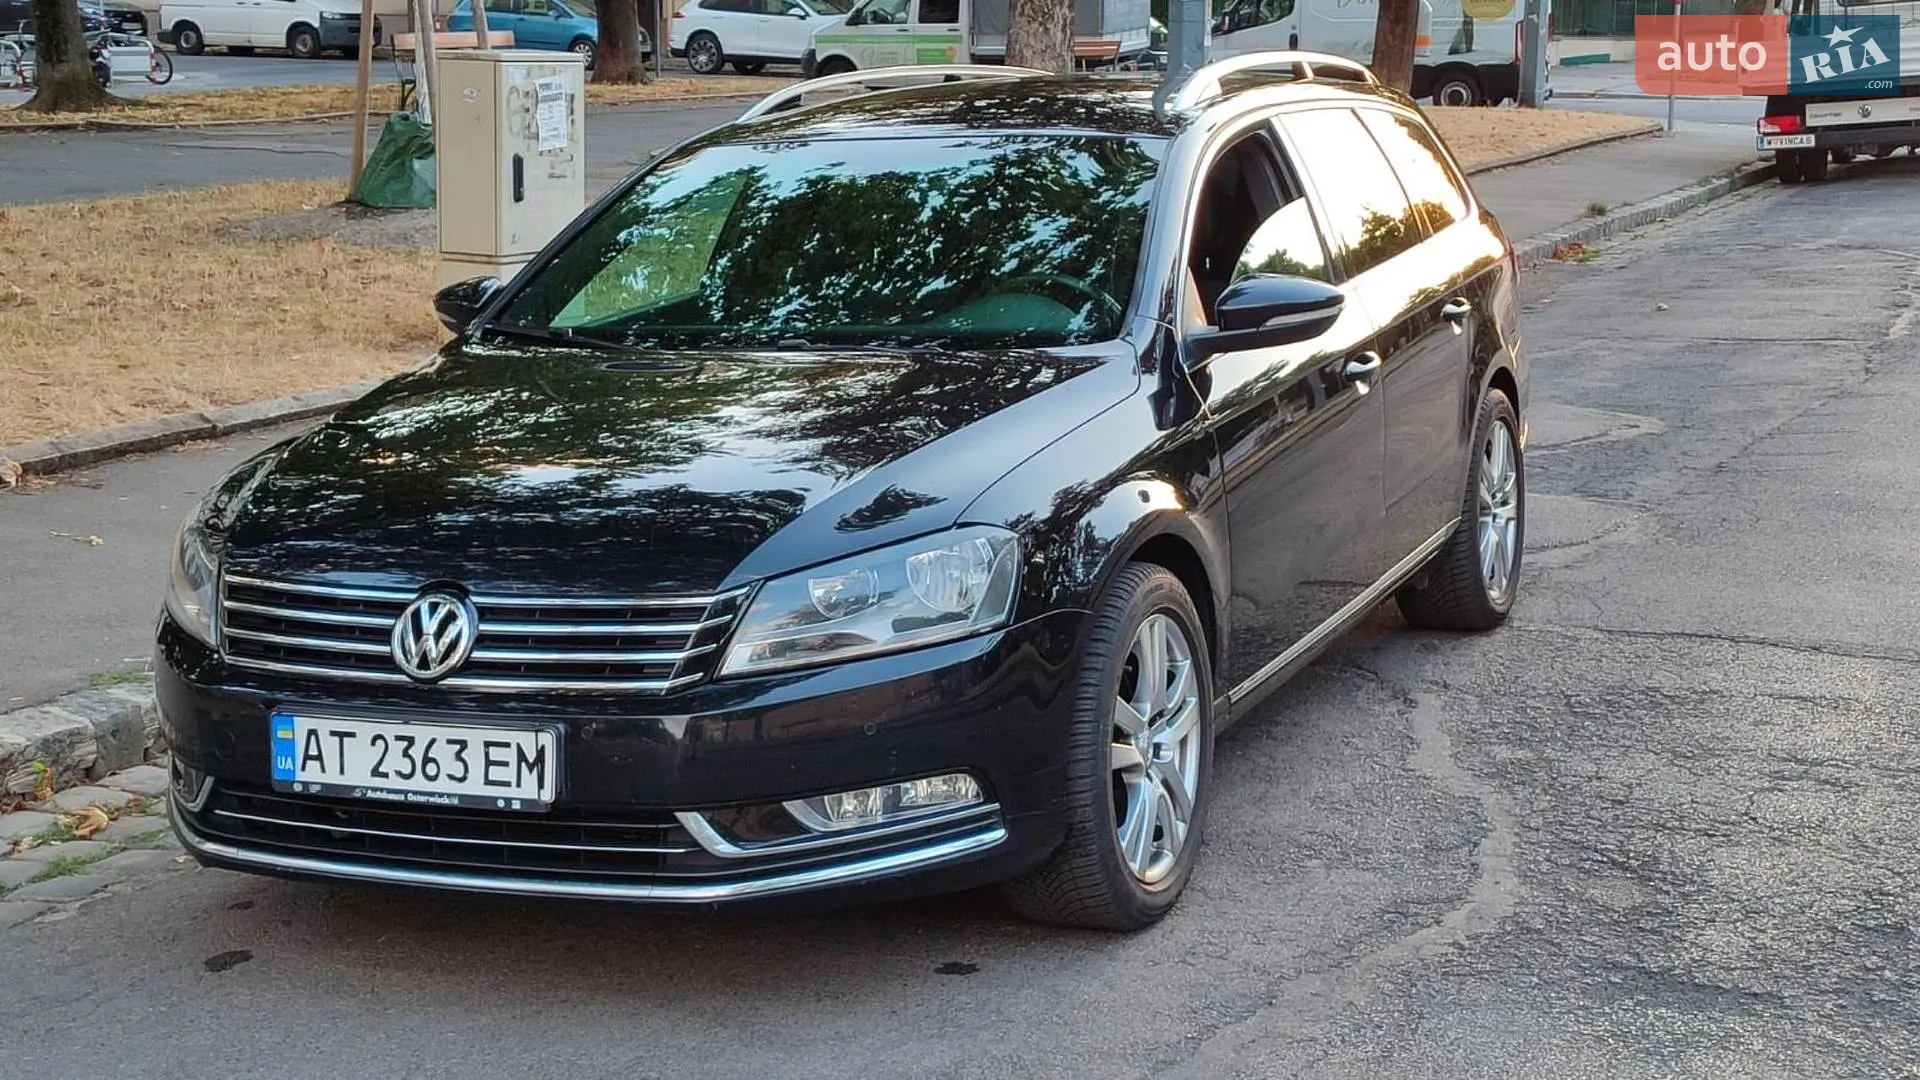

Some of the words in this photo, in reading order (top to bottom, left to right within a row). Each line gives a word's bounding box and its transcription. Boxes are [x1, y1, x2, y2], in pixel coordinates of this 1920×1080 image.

[277, 755, 294, 771] UA
[300, 728, 357, 776] AT
[369, 733, 470, 783] 2363
[482, 740, 546, 791] EM
